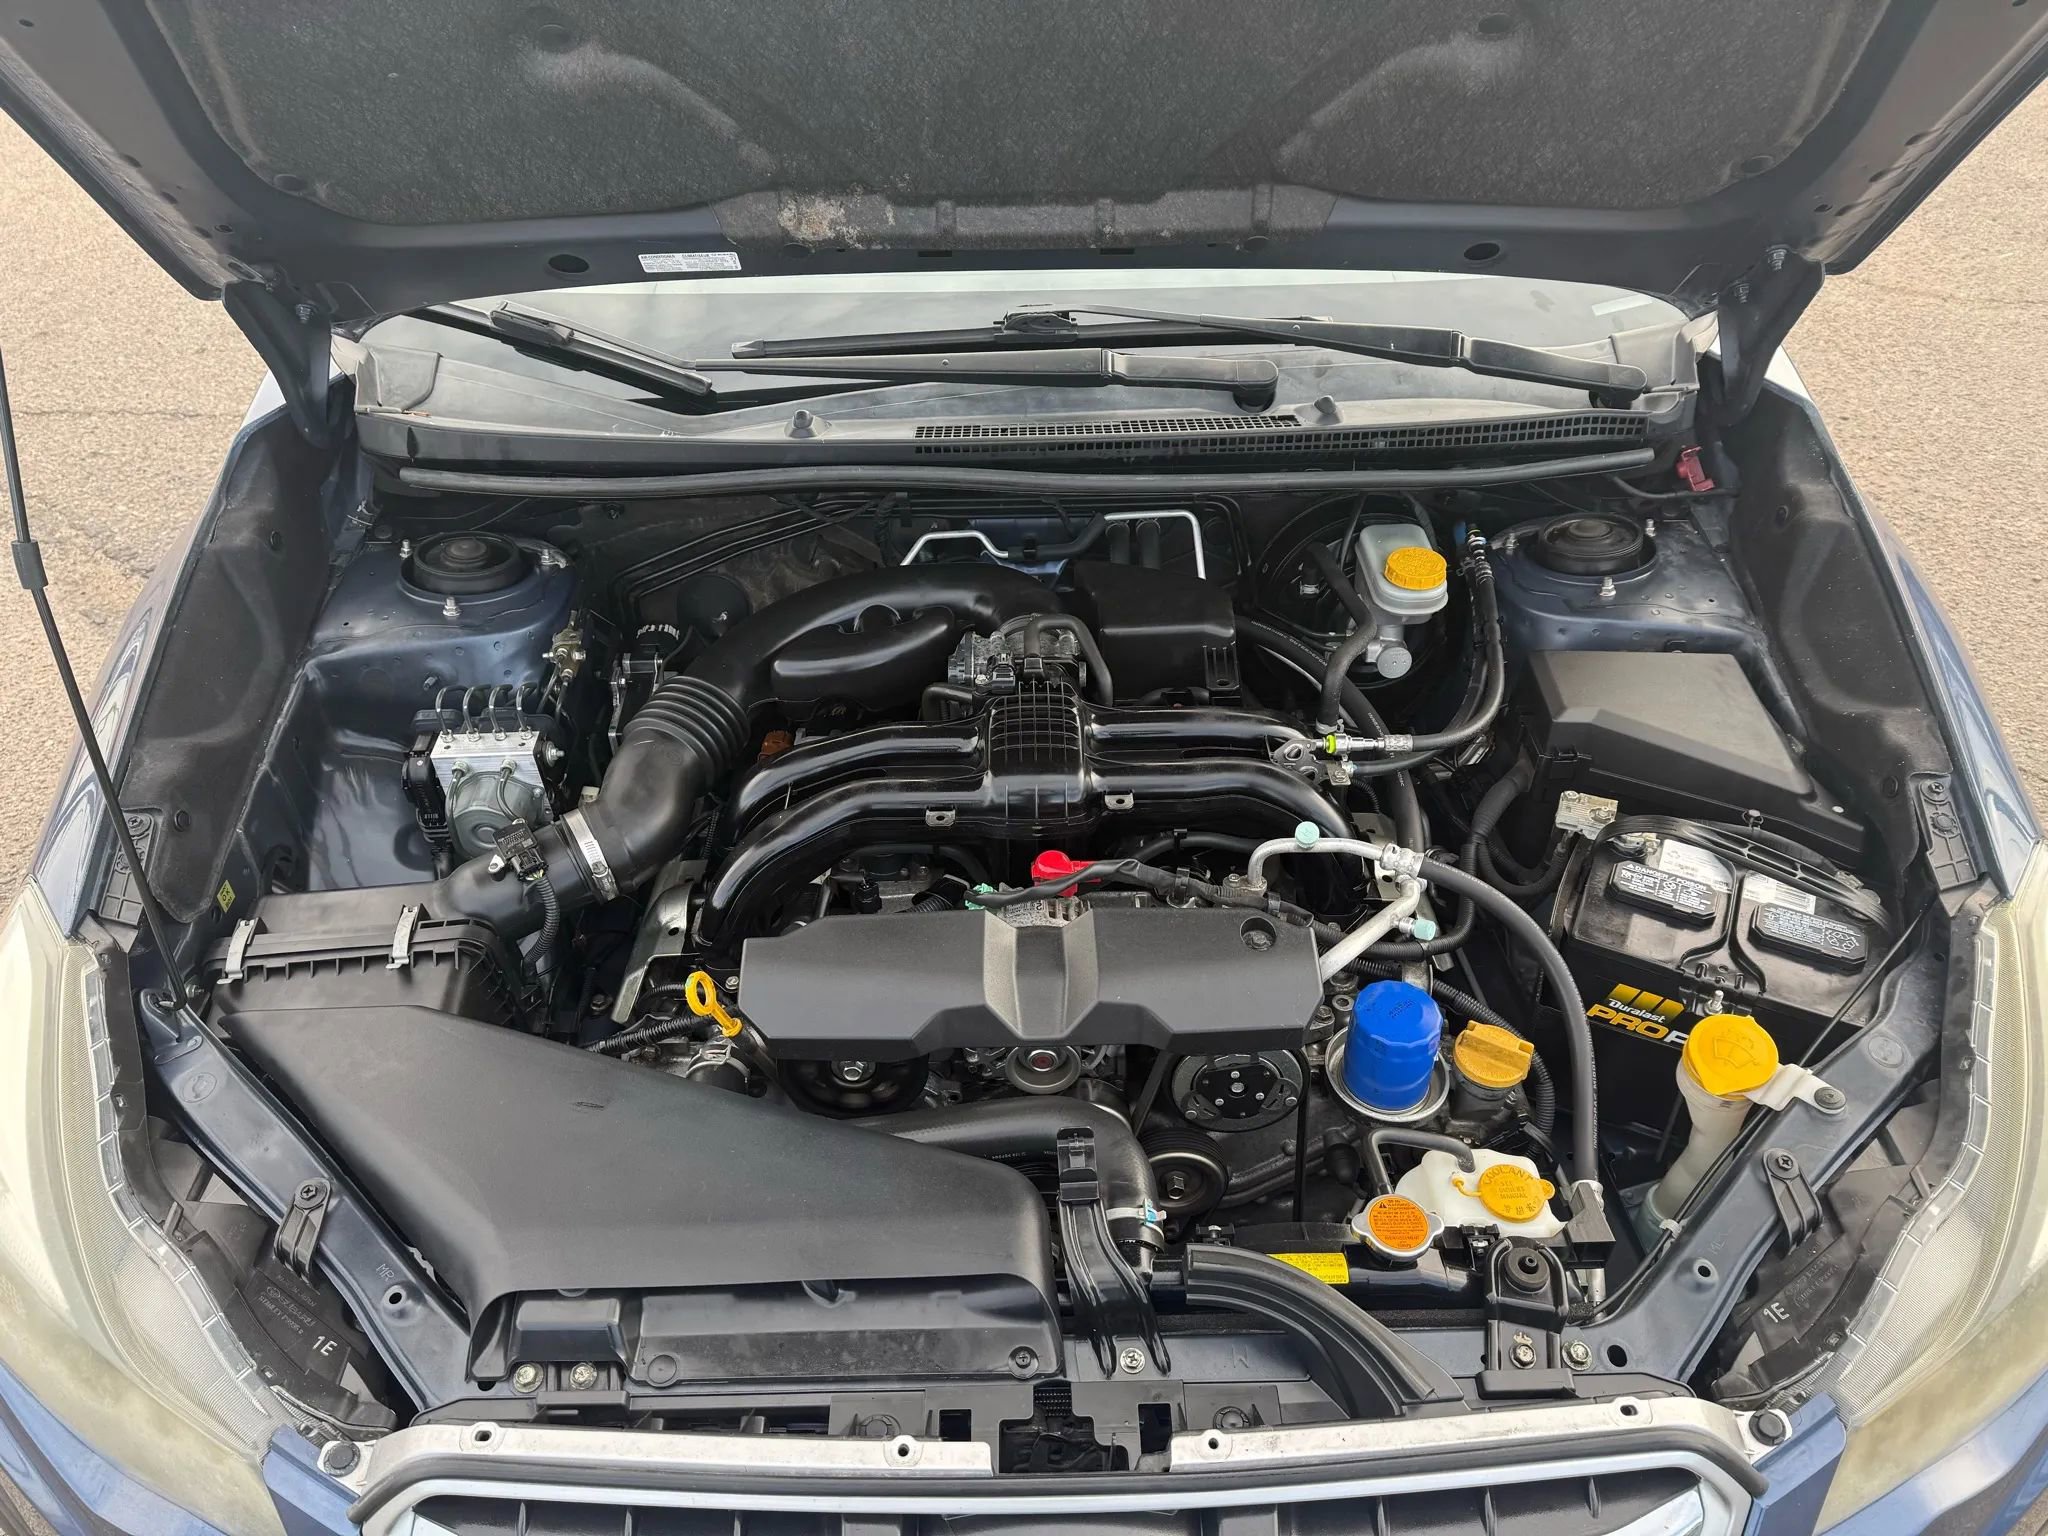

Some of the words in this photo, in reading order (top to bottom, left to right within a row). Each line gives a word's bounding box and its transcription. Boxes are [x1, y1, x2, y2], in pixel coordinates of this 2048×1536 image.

[1608, 998, 1666, 1023] Duralast
[375, 1263, 395, 1282] MR
[1763, 1302, 1790, 1323] 1E
[312, 1335, 338, 1356] 1E
